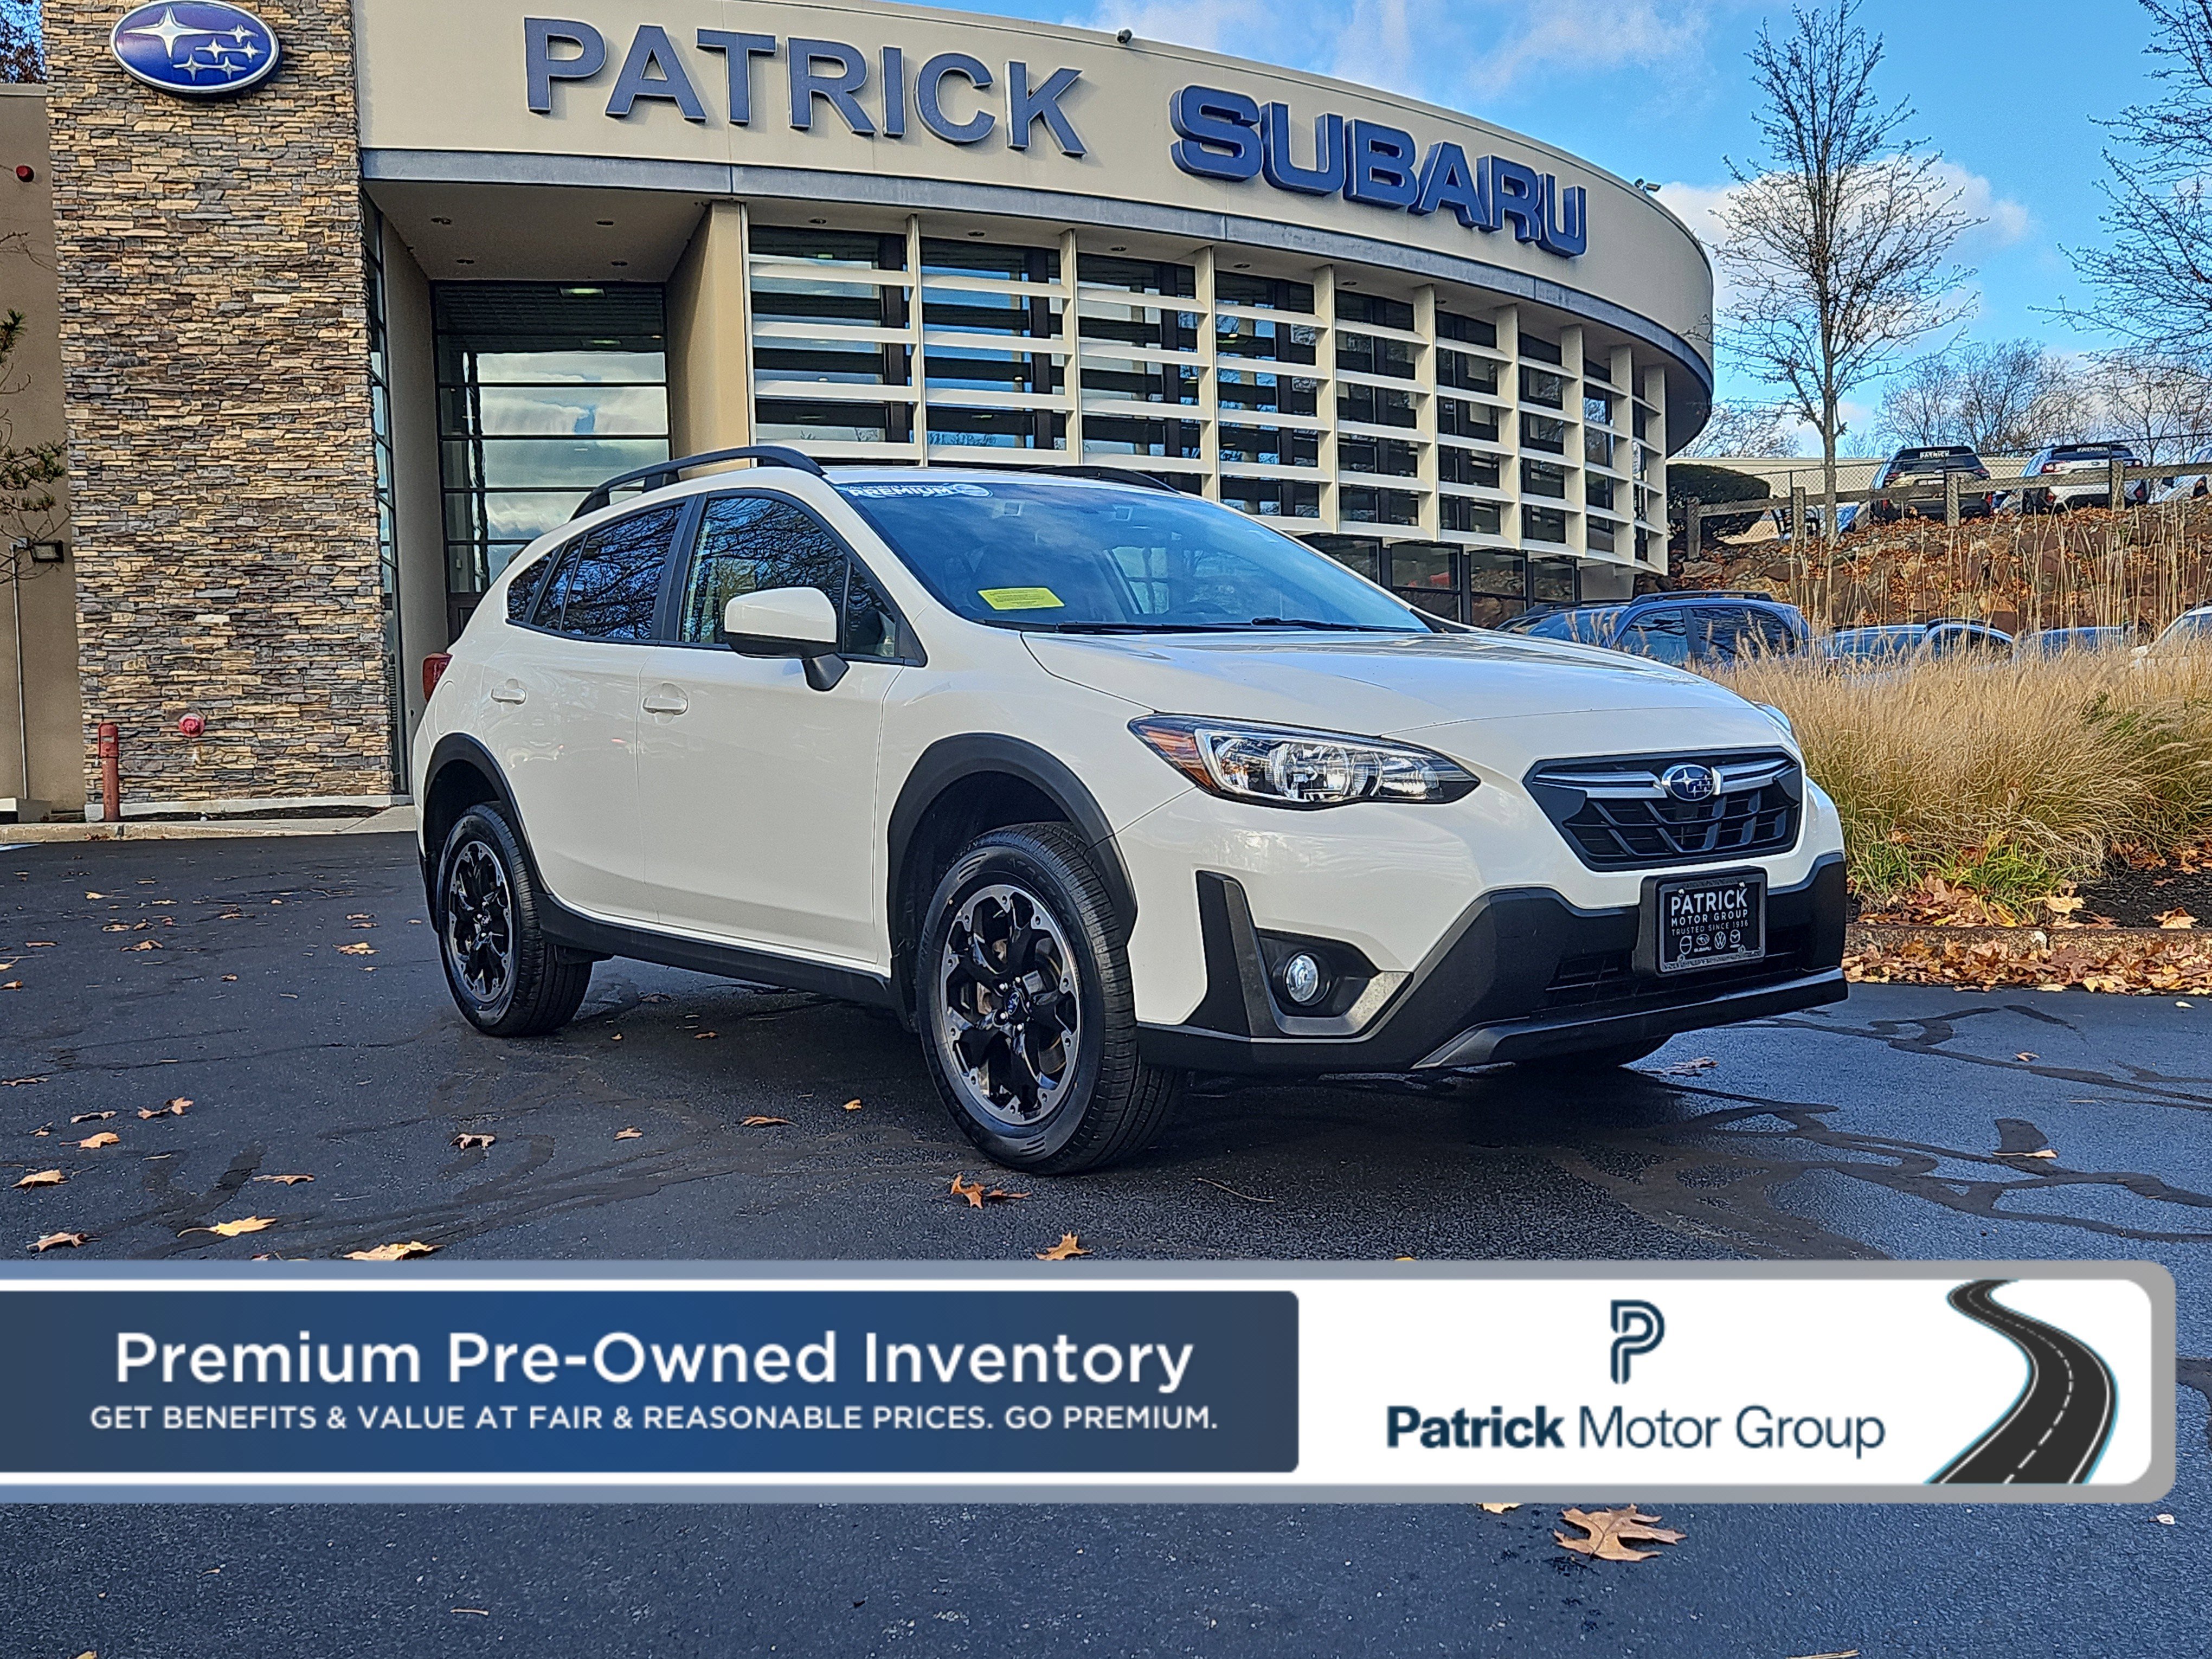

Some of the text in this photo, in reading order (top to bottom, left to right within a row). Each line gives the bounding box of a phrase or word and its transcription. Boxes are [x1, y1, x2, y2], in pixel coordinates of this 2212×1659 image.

[524, 16, 1587, 258] PATRICK SUBARU
[847, 485, 954, 497] PREMIUM
[1671, 888, 1748, 916] PATRICK
[1671, 909, 1748, 927] MOTOR GROUP
[1671, 926, 1705, 936] TRUSTED
[1708, 923, 1729, 932] SINCE
